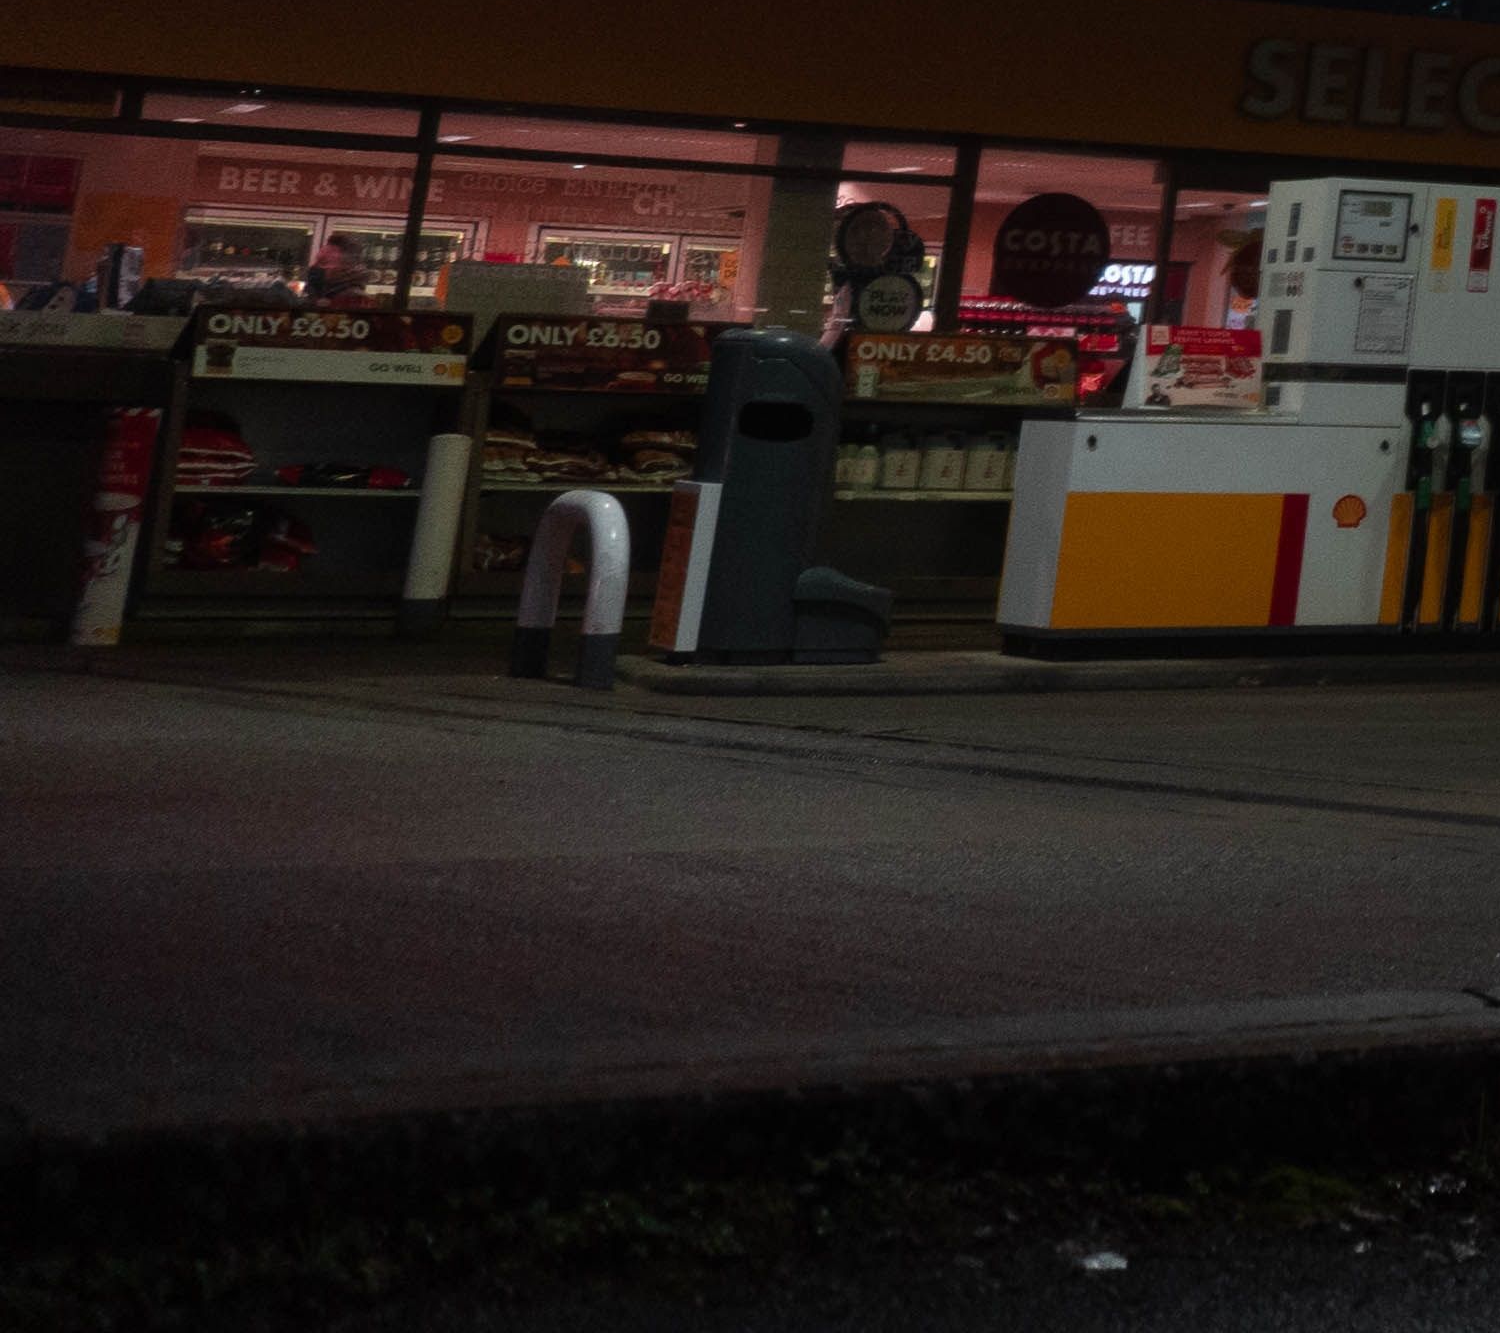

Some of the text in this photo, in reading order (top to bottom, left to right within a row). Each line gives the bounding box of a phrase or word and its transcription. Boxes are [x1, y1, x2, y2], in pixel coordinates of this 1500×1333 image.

[219, 166, 301, 193] BEER
[313, 173, 338, 196] &
[1005, 229, 1102, 255] COSTA
[208, 314, 370, 341] ONLY £6.50
[507, 324, 578, 347] ONLY
[857, 340, 992, 364] ONLY £4.50
[663, 372, 683, 384] GO
